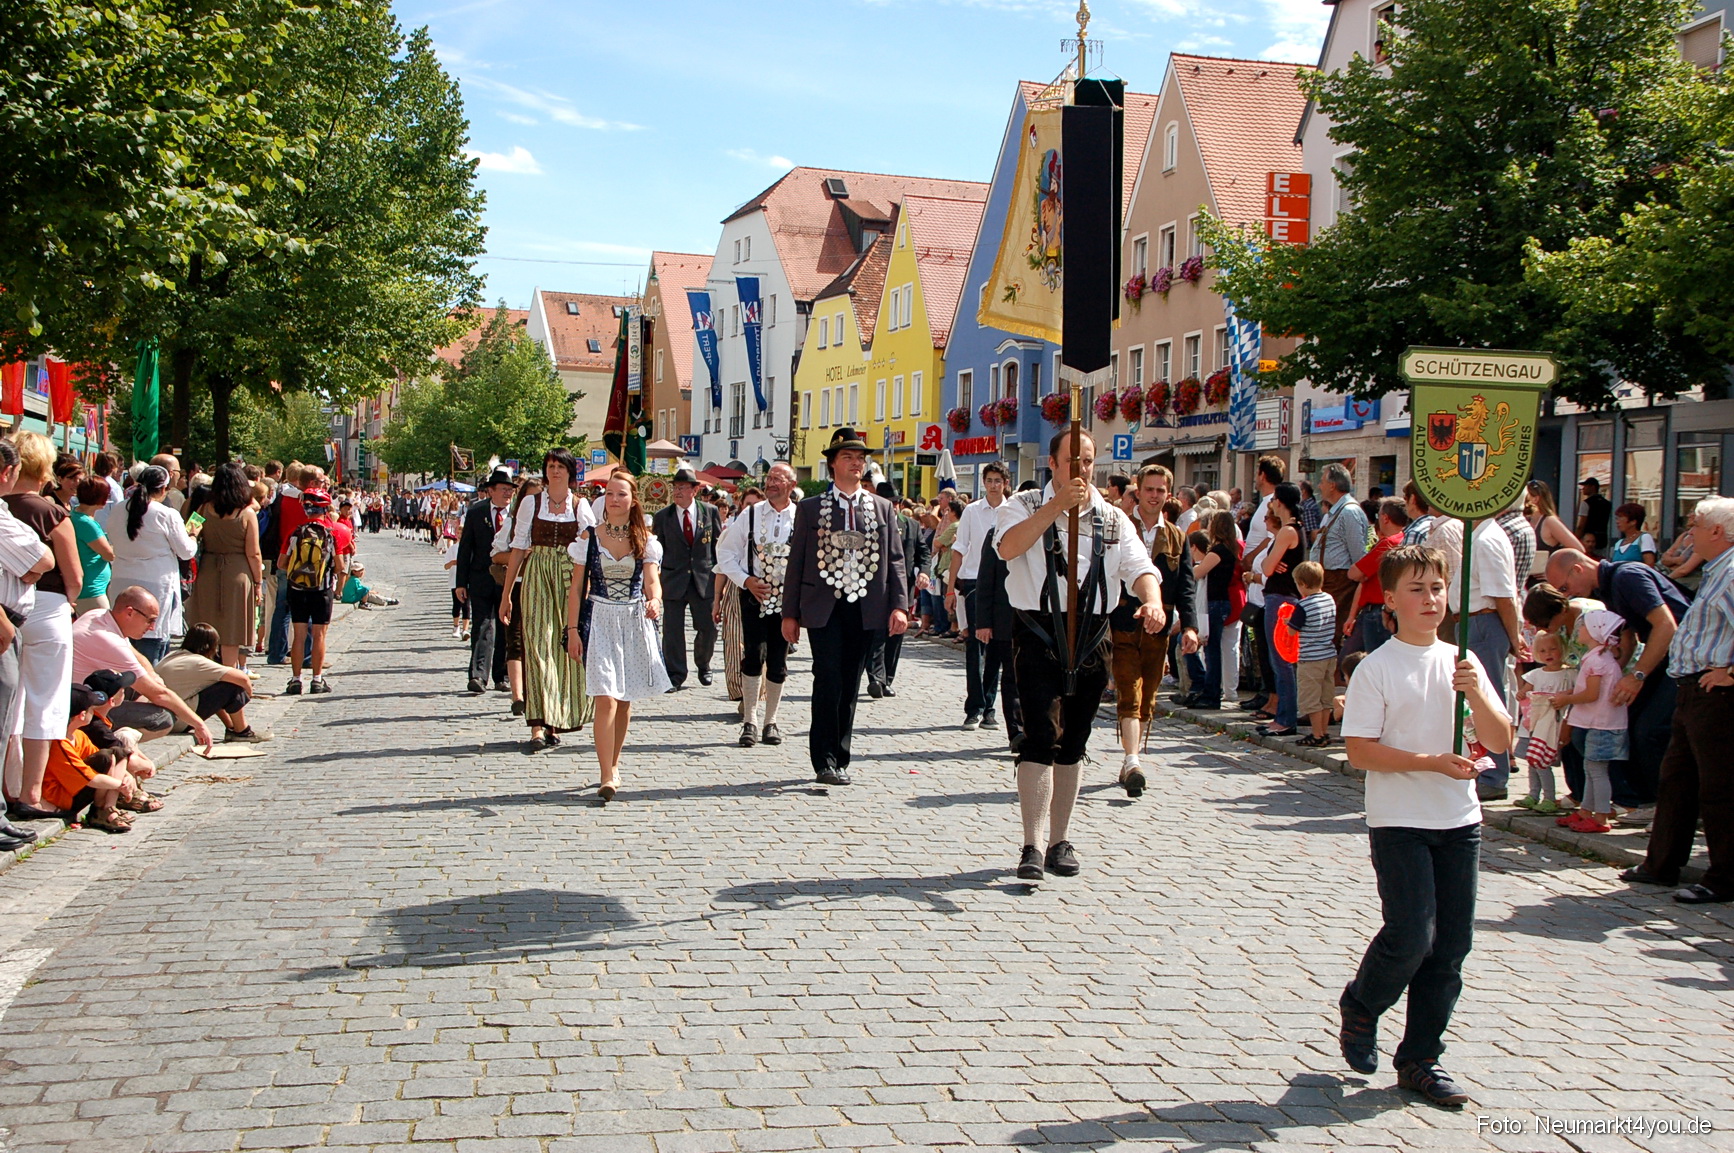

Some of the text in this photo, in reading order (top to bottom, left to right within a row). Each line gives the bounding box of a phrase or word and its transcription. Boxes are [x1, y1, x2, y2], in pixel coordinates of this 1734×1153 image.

[826, 366, 843, 382] HOTEL
[1414, 358, 1542, 380] SCHÜTZENGAU
[1117, 437, 1129, 458] P
[1415, 424, 1532, 513] ALTDORF-NEUMARKT-BEILNGRIES
